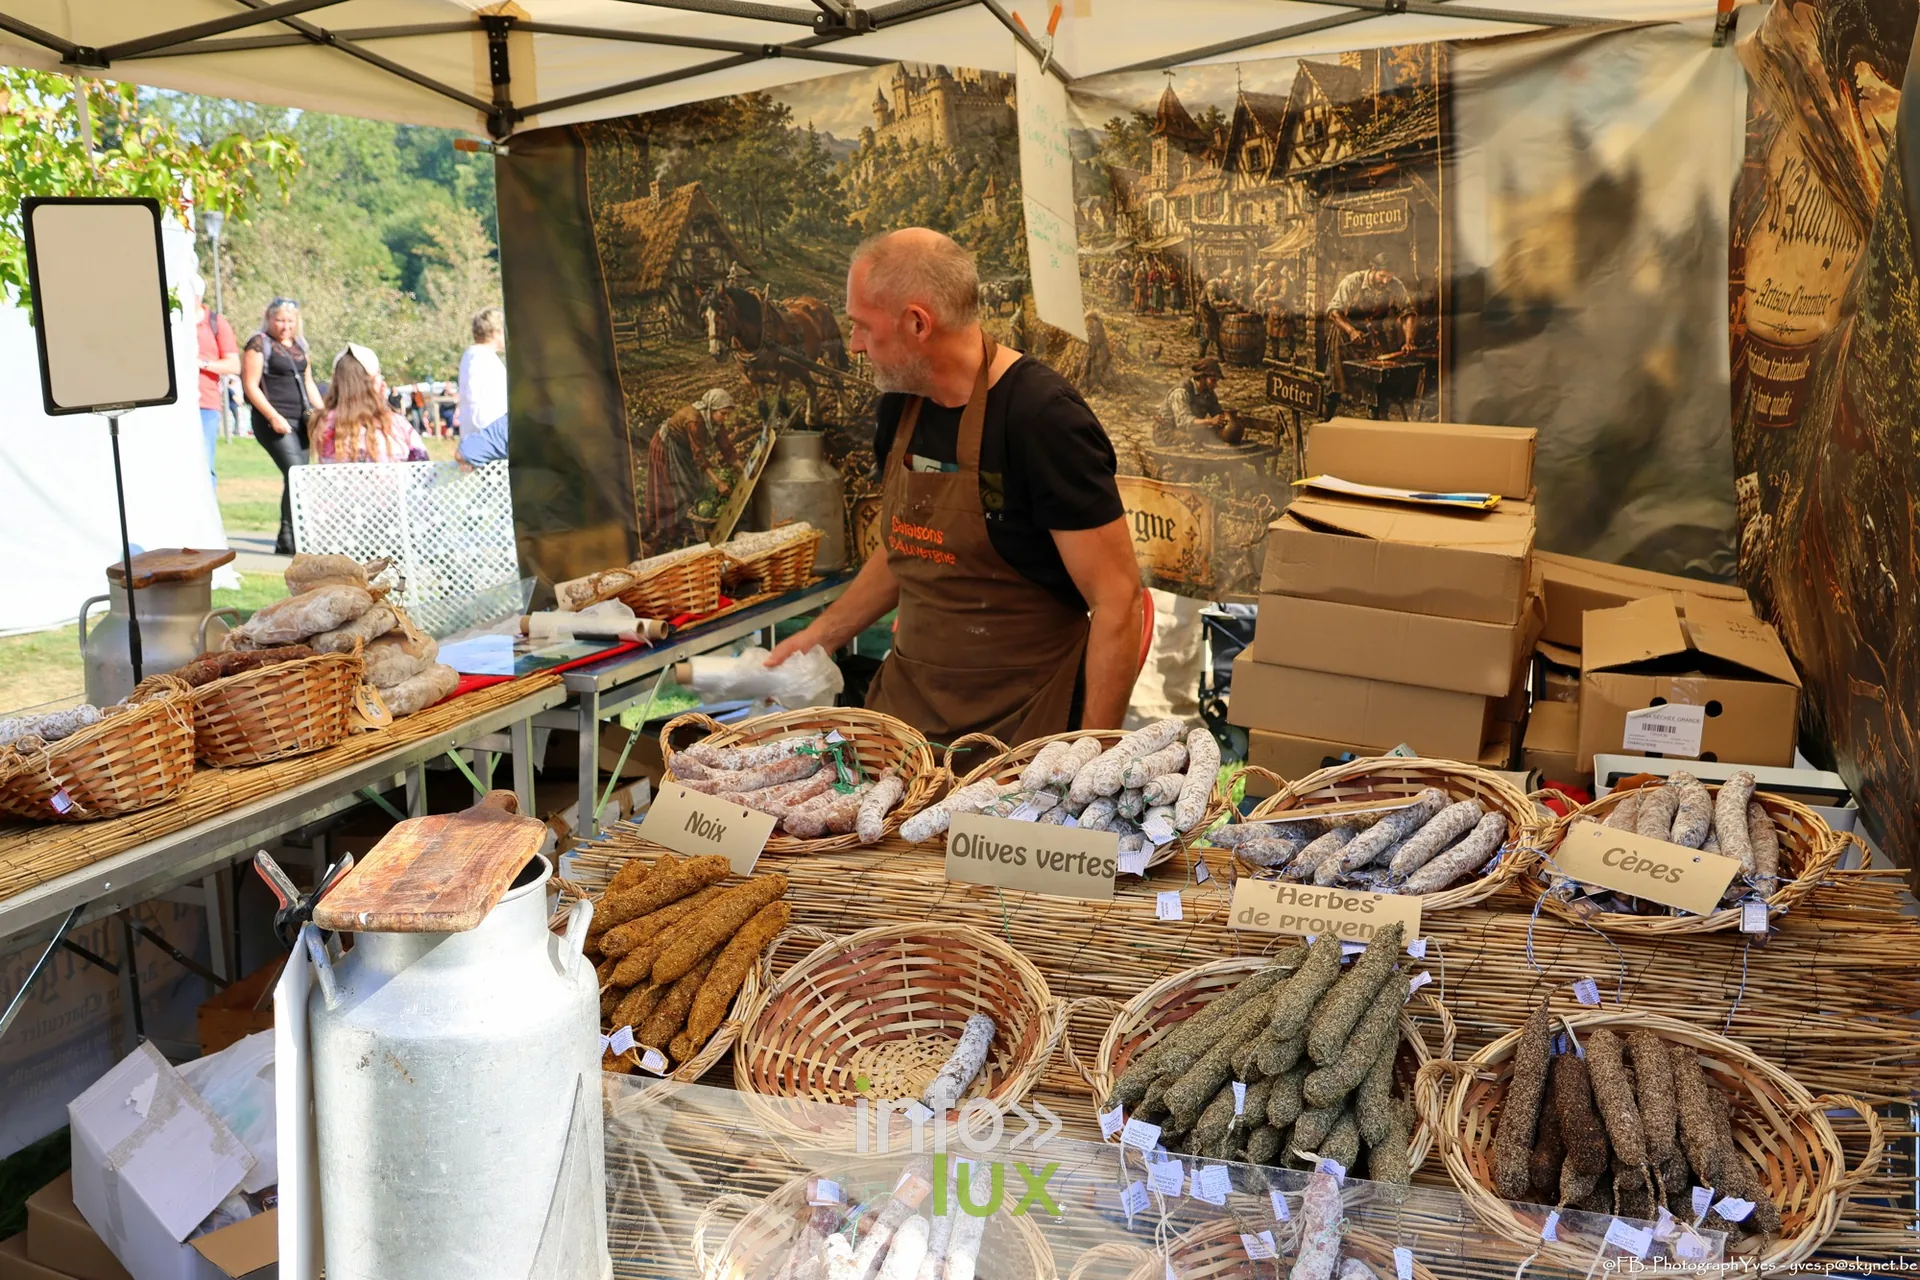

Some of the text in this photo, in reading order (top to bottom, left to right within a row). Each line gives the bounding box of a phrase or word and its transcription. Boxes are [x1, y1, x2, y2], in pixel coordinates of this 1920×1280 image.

[1343, 207, 1402, 230] Forgeron
[1272, 376, 1314, 406] Potier
[684, 811, 727, 843] Noix
[952, 832, 1027, 866] Olives
[1036, 848, 1116, 879] vertes
[1602, 847, 1685, 884] Cèpes
[1276, 886, 1375, 914] Herbes
[1237, 906, 1407, 942] de proven
